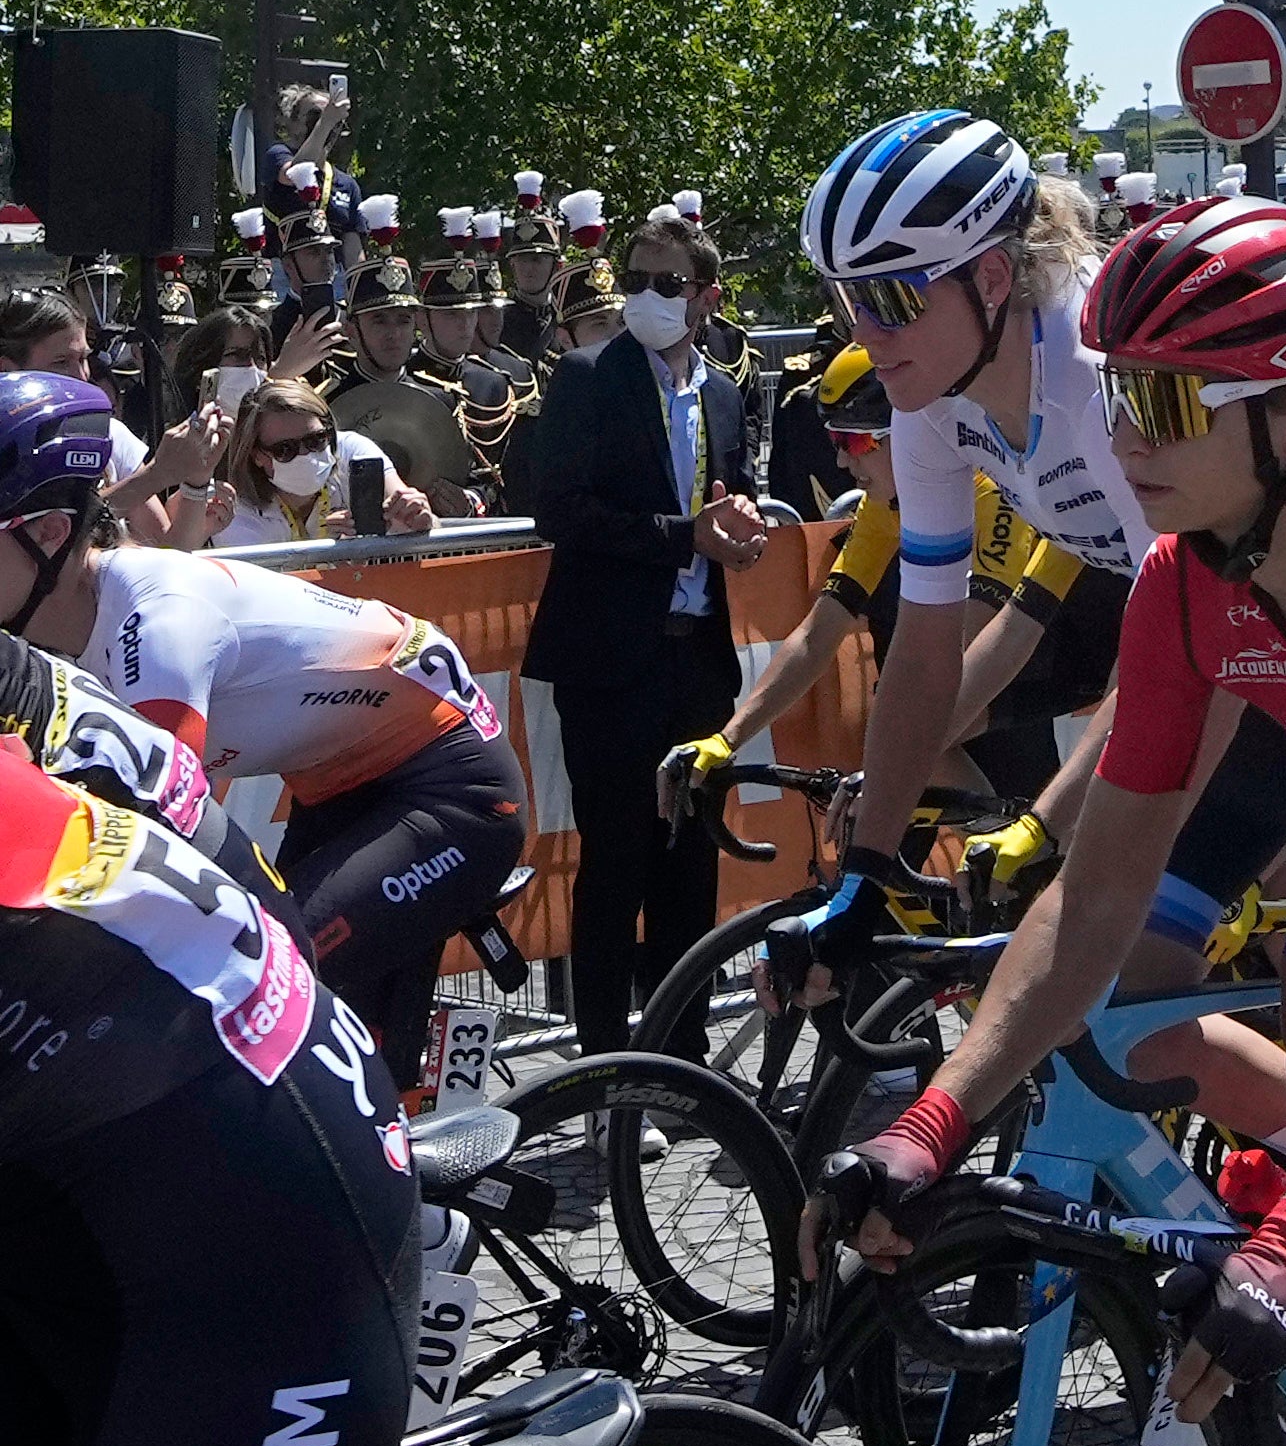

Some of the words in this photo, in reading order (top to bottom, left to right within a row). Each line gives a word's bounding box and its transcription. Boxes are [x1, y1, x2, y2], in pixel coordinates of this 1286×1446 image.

[955, 168, 1019, 235] TREK
[71, 453, 98, 466] LEM
[300, 688, 391, 708] THORNE
[381, 844, 467, 905] Optum
[0, 1000, 71, 1073] ore
[445, 1022, 490, 1093] 233
[411, 1298, 469, 1408] 206
